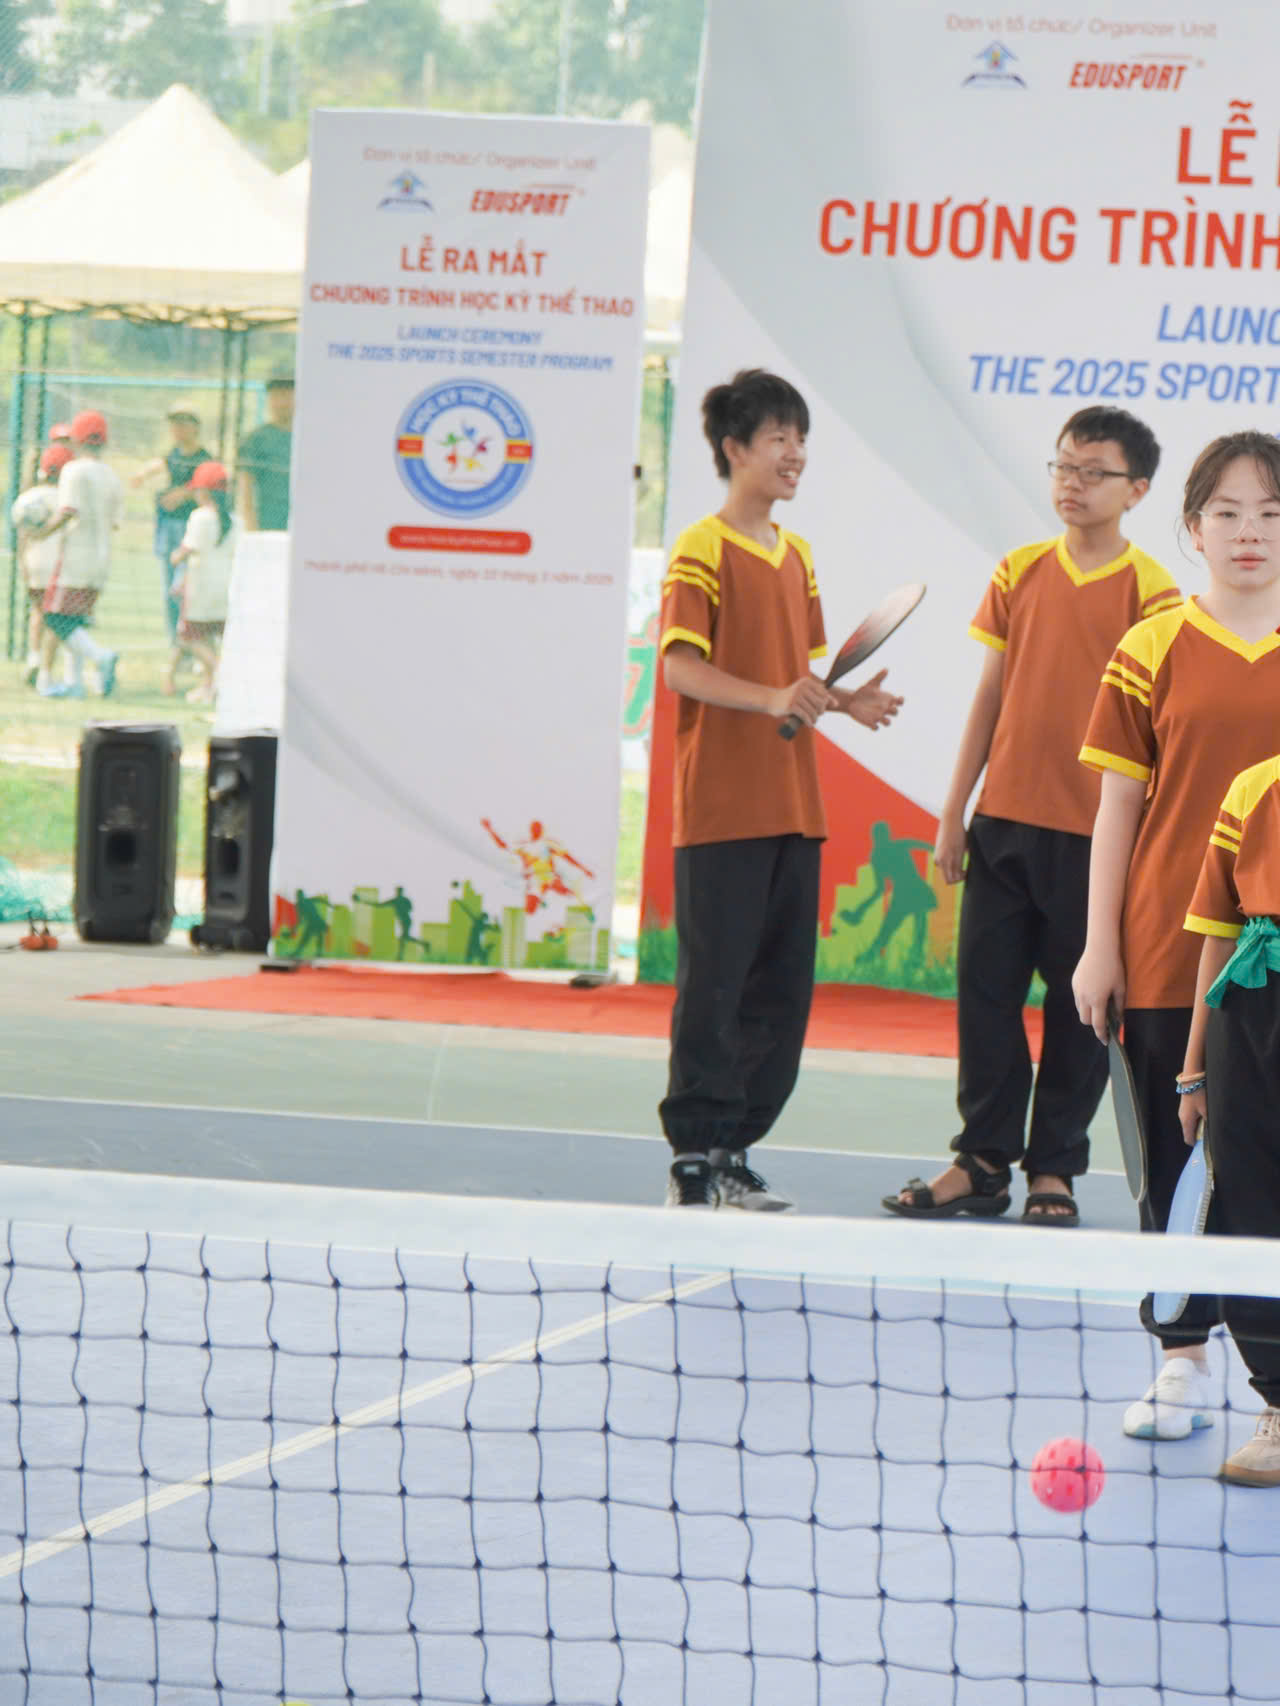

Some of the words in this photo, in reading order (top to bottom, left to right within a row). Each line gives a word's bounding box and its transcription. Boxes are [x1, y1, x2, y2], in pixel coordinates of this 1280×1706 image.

[1088, 18, 1174, 38] Organizer
[1180, 20, 1218, 38] Unit
[1070, 62, 1186, 90] EDUSPORT
[1177, 100, 1256, 186] LỄ
[470, 189, 570, 215] EDUSPORT
[820, 197, 1076, 263] CHƯƠNG
[401, 234, 435, 273] LỄ
[443, 247, 480, 274] RA
[489, 240, 547, 276] MẮT
[311, 284, 390, 304] CHƯƠNG
[397, 286, 455, 308] TRÌNH
[460, 291, 500, 315] HỌC
[582, 296, 633, 317] THAO
[398, 325, 460, 345] LAUNCH
[461, 328, 543, 346] CEREMONY
[327, 343, 354, 360] THE
[357, 345, 394, 361] 2025
[399, 346, 457, 364] SPORTS
[460, 349, 538, 368] SEMESTER
[540, 352, 613, 372] PROGRAM
[970, 355, 1044, 394] THE
[1050, 358, 1149, 398] 2025
